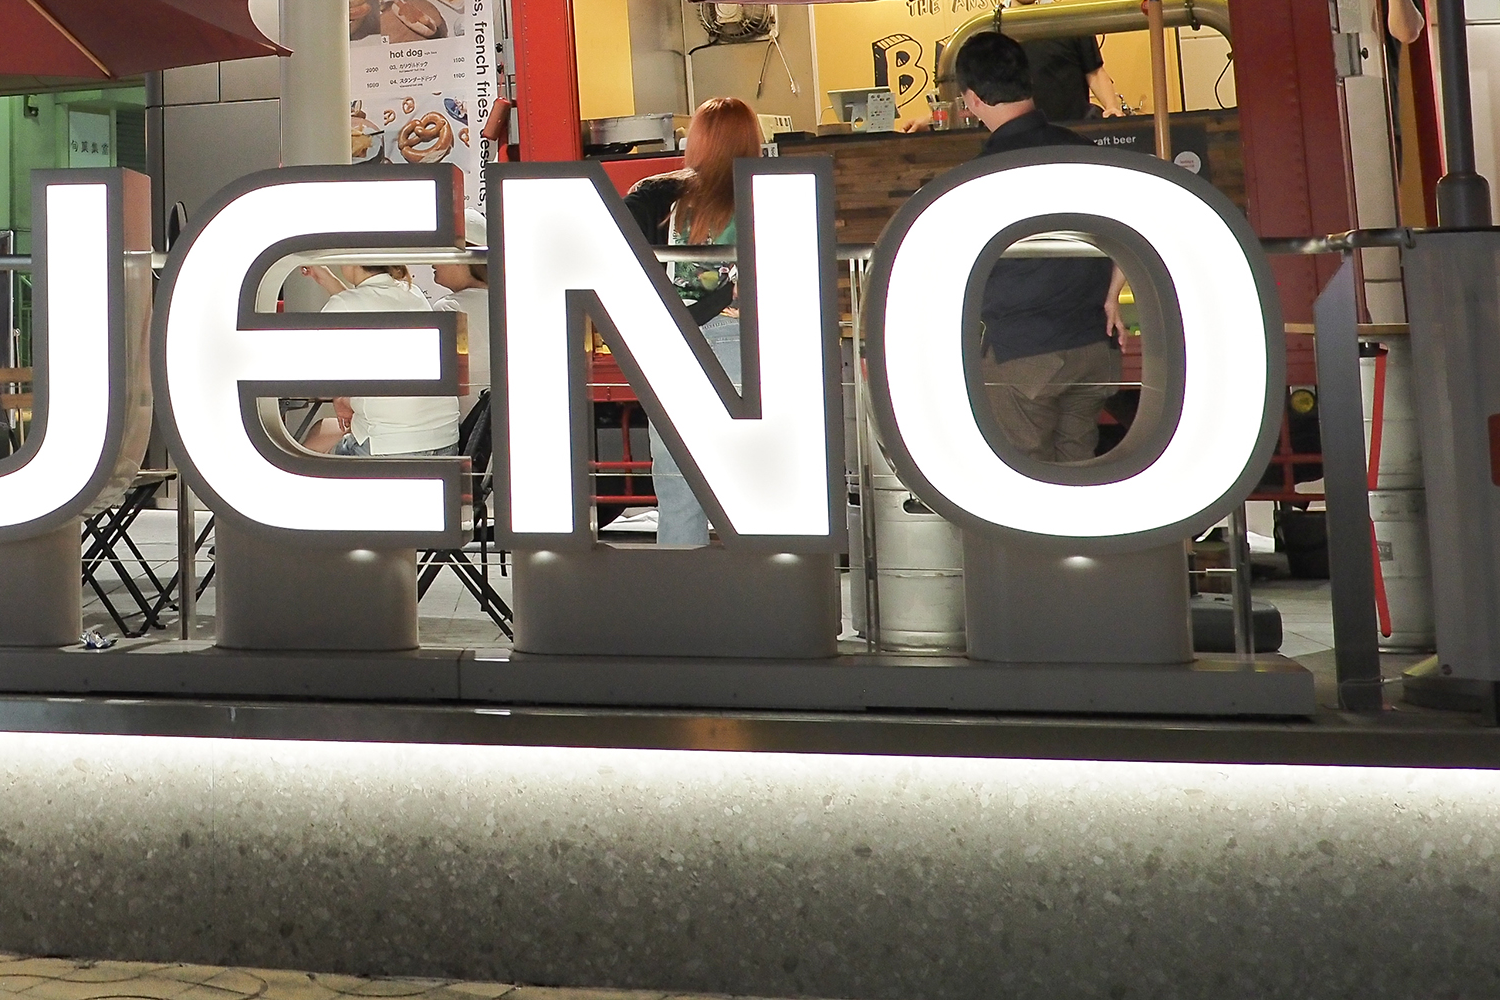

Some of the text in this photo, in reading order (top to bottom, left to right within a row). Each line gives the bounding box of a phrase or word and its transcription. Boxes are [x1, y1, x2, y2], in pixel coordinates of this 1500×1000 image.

[389, 50, 404, 59] hot
[406, 48, 423, 58] dog
[473, 21, 489, 76] french
[476, 80, 490, 123] fries,
[1093, 135, 1137, 146] raft beer
